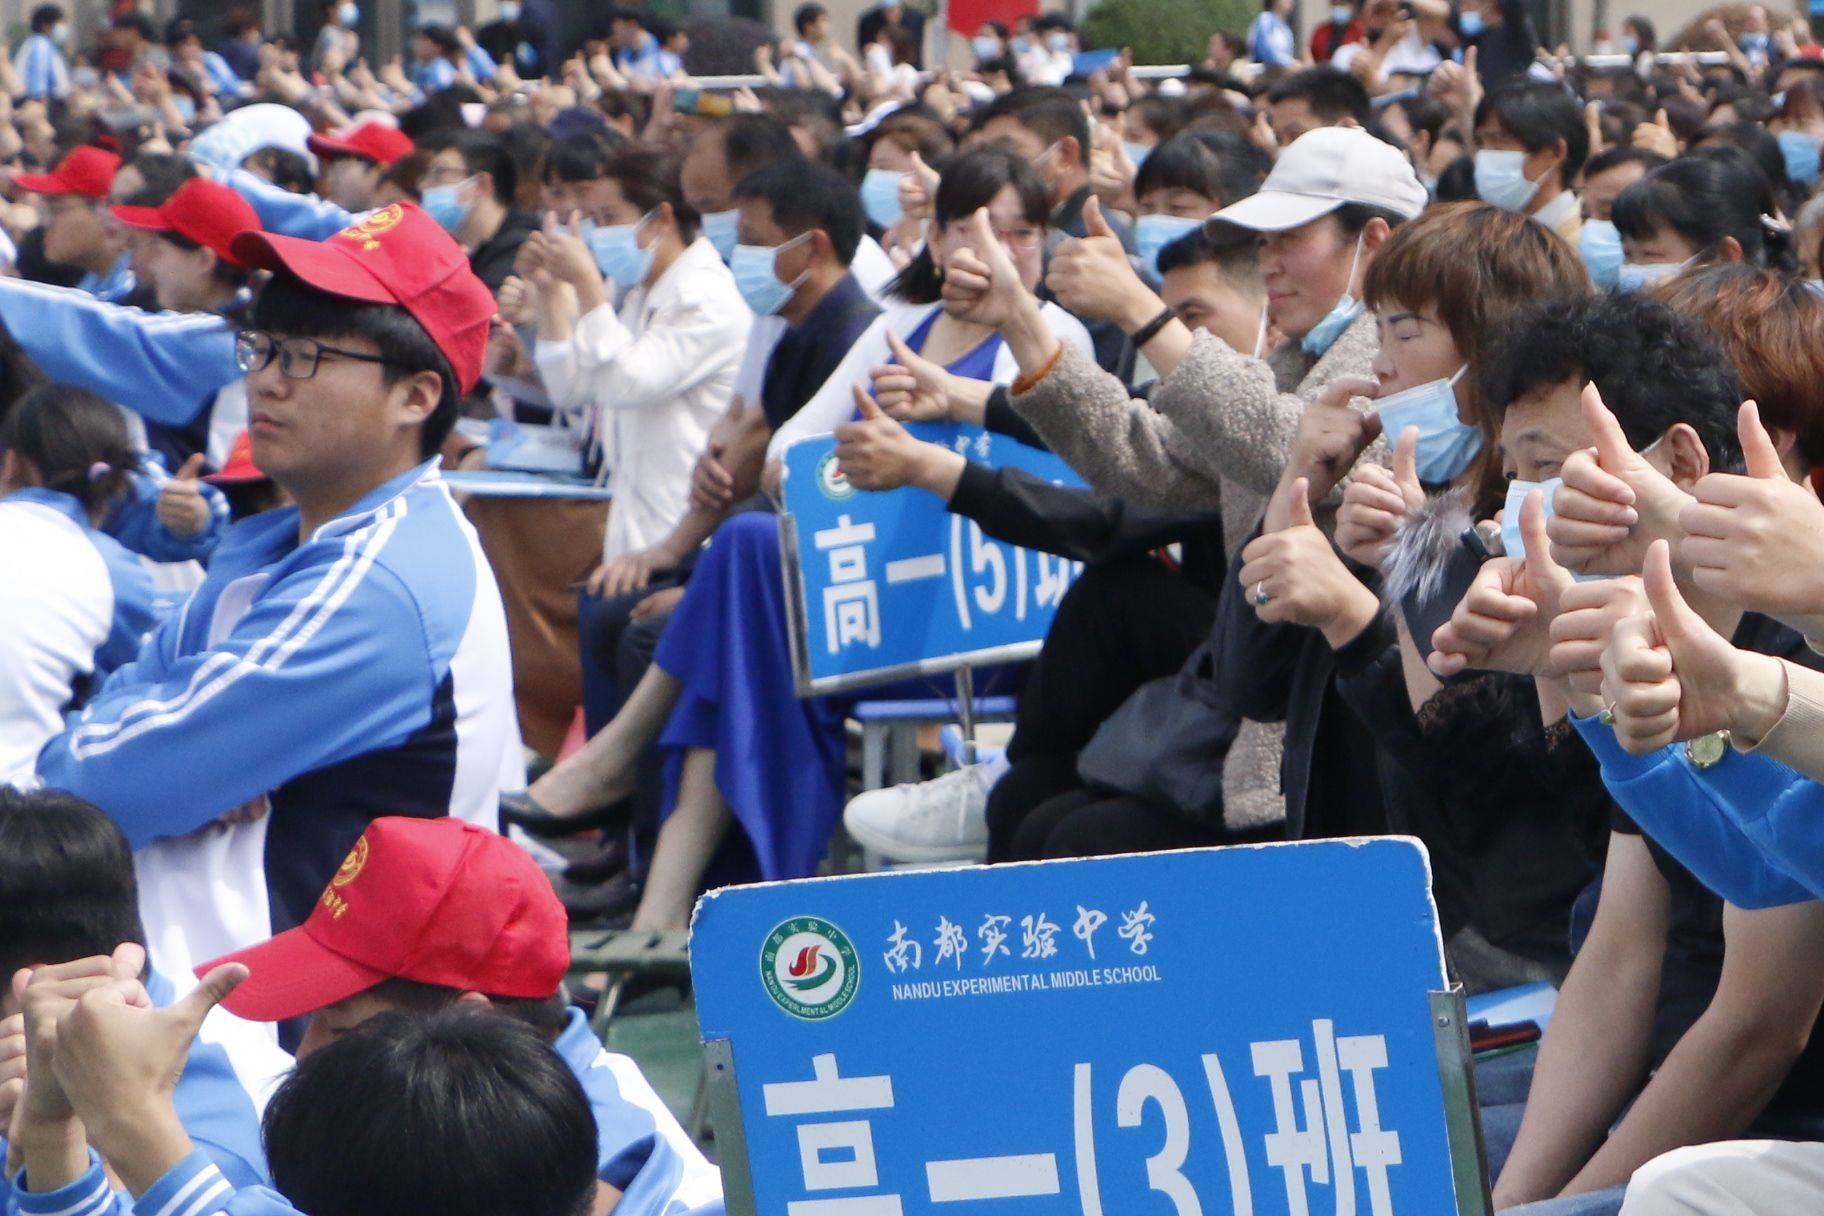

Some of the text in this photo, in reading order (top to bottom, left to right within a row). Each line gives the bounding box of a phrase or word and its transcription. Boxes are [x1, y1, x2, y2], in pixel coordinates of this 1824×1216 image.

[884, 900, 1156, 974] 南都实验中学
[892, 965, 1162, 1001] NANDU EXPERIMENTAL MIDDLE SCHOOL
